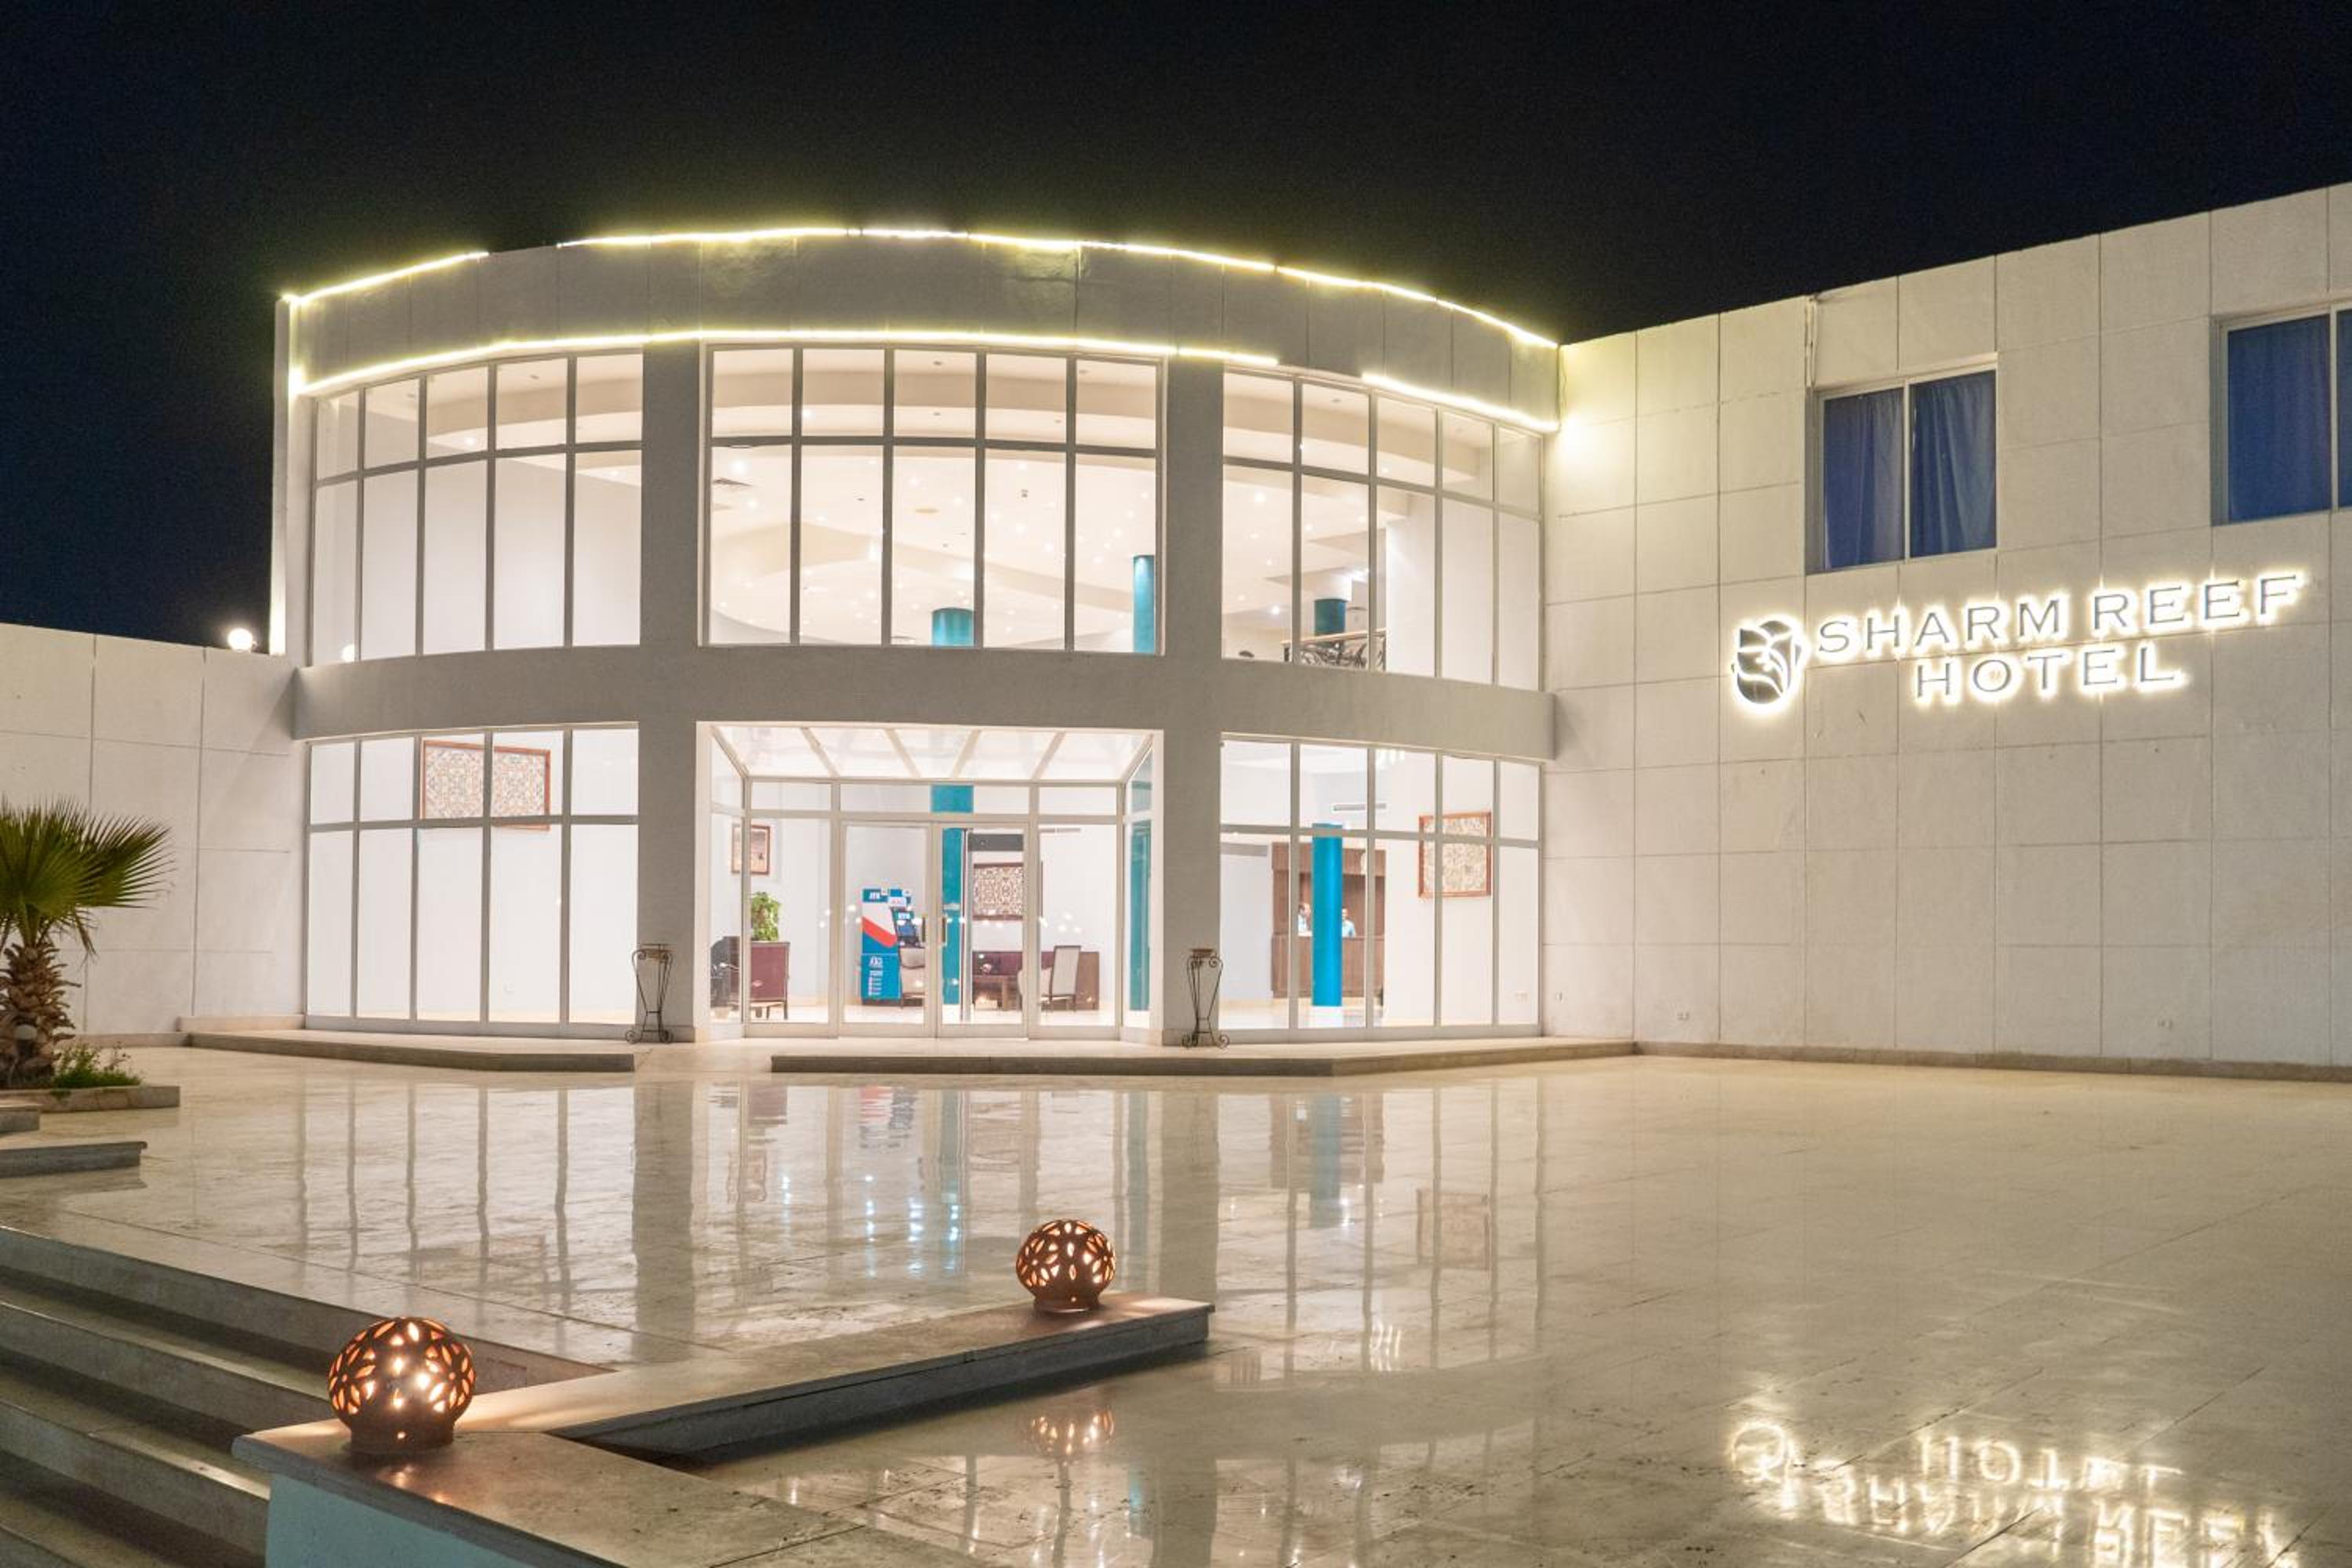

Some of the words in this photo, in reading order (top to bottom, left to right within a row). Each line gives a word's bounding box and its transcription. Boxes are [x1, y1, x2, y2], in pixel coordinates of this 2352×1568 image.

[1817, 598, 2060, 654] SHARM
[2092, 574, 2298, 630] REEF
[1915, 645, 2176, 699] HOTEL
